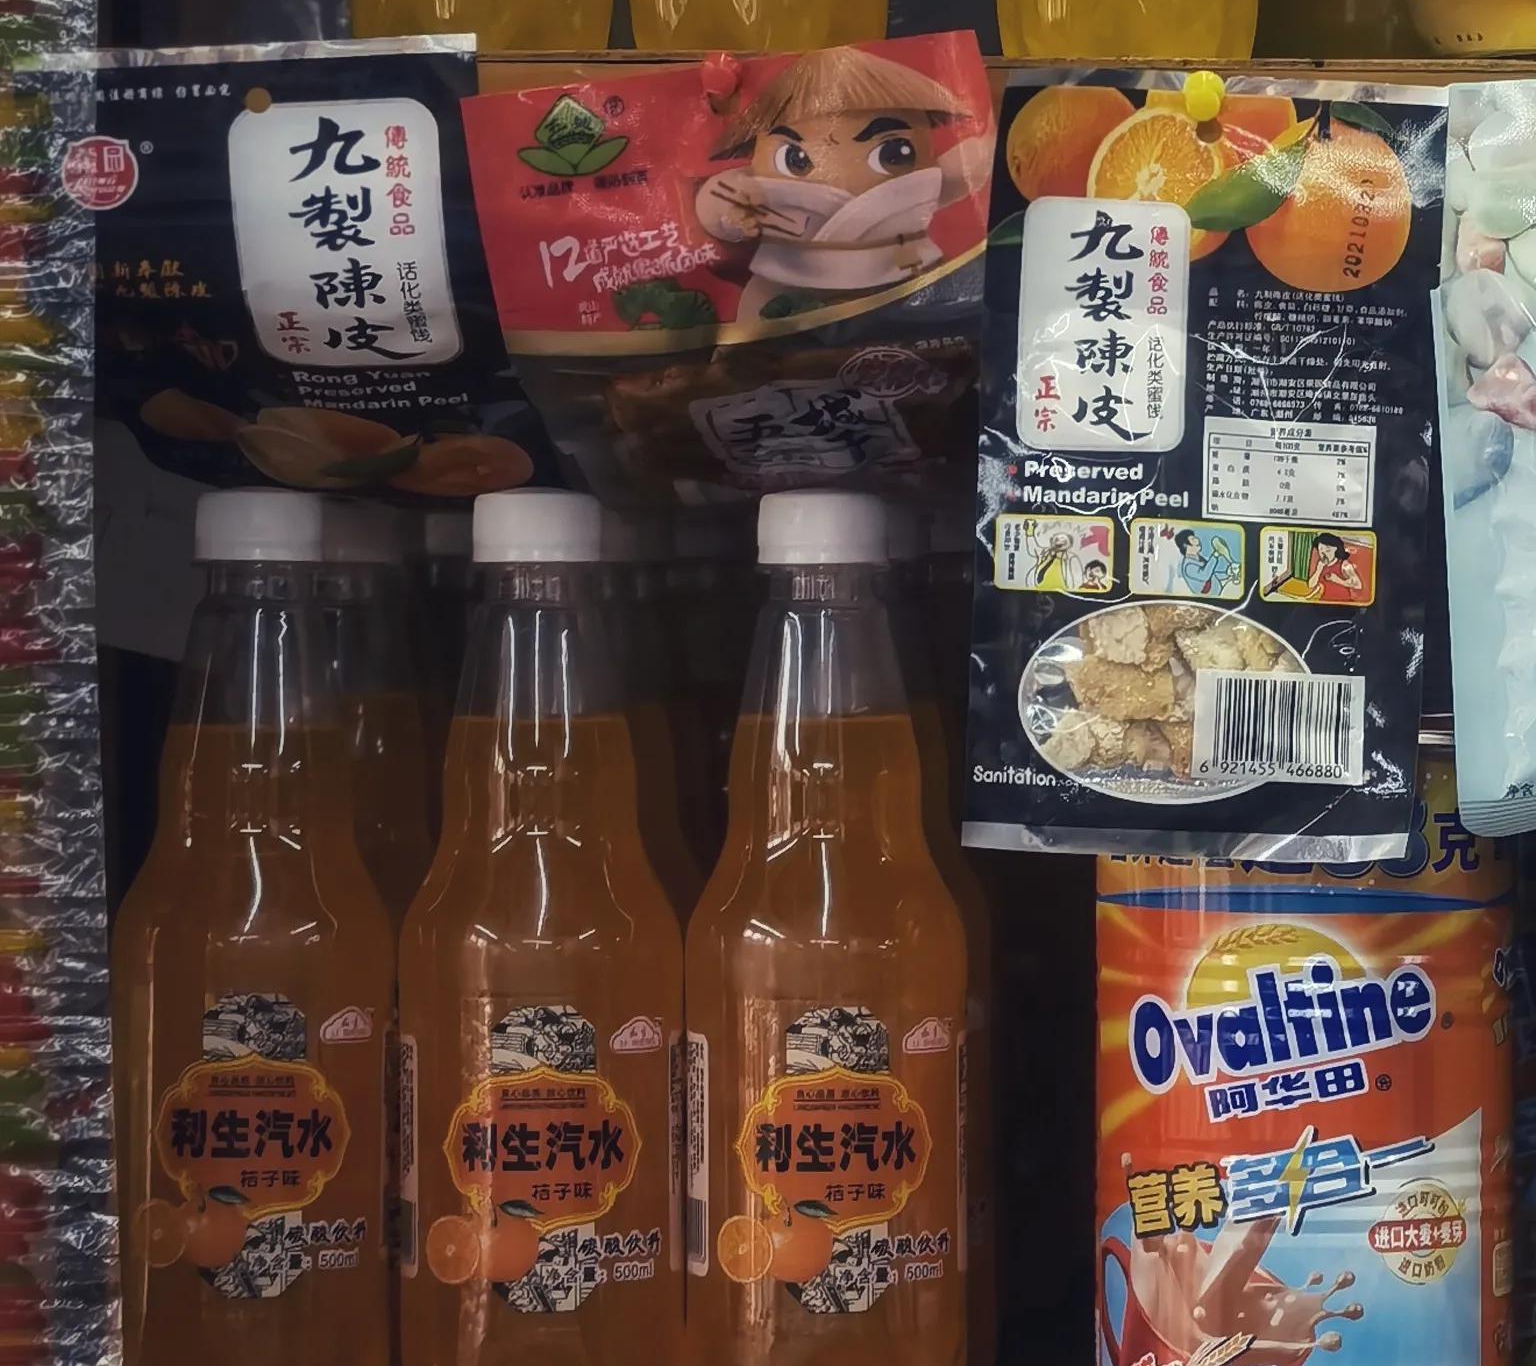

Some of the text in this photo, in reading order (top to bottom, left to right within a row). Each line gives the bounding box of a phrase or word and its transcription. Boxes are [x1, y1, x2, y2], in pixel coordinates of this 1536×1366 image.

[383, 125, 416, 236] 傳統食品
[289, 117, 426, 360] 九製陳皮
[1146, 226, 1171, 316] 傳統食品
[1064, 211, 1151, 442] 九製陳皮
[292, 371, 359, 386] Rong
[298, 380, 417, 397] Preserved
[303, 392, 468, 410] Mandarin Peel
[1033, 375, 1061, 433] 正宗
[1023, 461, 1143, 481] Preserved
[1022, 485, 1189, 509] Mandarin Peel
[1199, 761, 1343, 779] 6 921455 466880
[1135, 955, 1436, 1087] Ovaltine
[1211, 1061, 1368, 1120] 阿华田
[170, 1108, 333, 1161] 利生汽水
[461, 1122, 624, 1174] 利生汽水
[755, 1122, 918, 1174] 利生汽水
[239, 1169, 302, 1189] 桔子味
[531, 1183, 595, 1202] 桔子味
[824, 1183, 887, 1203] 桔子味
[318, 1250, 360, 1270] 500ml
[612, 1261, 655, 1282] 500ml
[904, 1260, 946, 1282] 500ml
